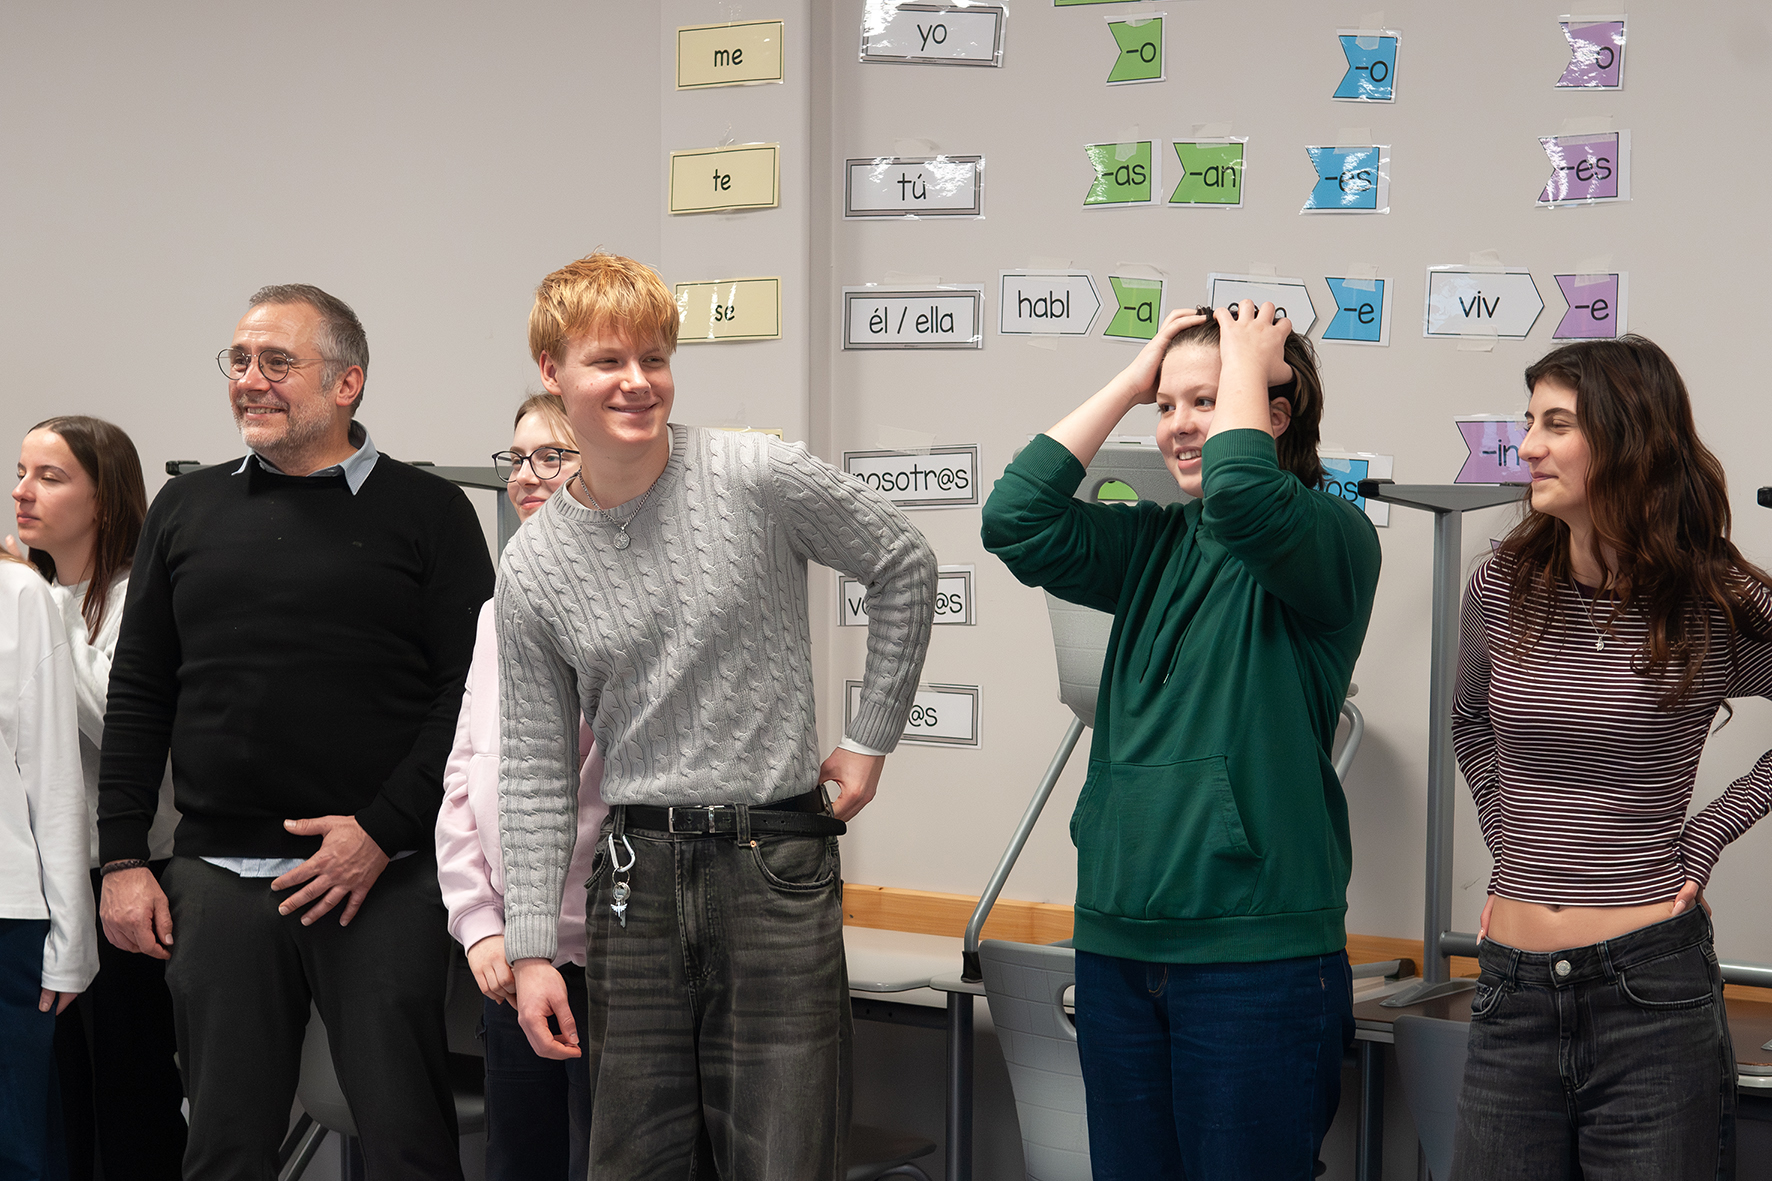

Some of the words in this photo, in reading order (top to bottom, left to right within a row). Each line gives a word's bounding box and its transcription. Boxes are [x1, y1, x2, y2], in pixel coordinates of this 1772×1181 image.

[916, 23, 947, 52] yo
[714, 48, 743, 68] me
[1125, 41, 1157, 64] -o
[1354, 60, 1389, 83] -o
[712, 168, 731, 192] te
[1101, 164, 1147, 187] -as
[1189, 165, 1237, 188] -an
[1324, 169, 1373, 193] -es
[1559, 157, 1612, 182] -es
[897, 172, 927, 201] tú
[714, 304, 735, 322] se
[1017, 289, 1070, 319] habl
[1123, 301, 1153, 324] -a
[1343, 302, 1375, 325] -e
[1459, 291, 1501, 319] viv
[1574, 298, 1610, 321] -e
[868, 306, 889, 334] él
[897, 306, 908, 335] /
[915, 305, 955, 334] ella
